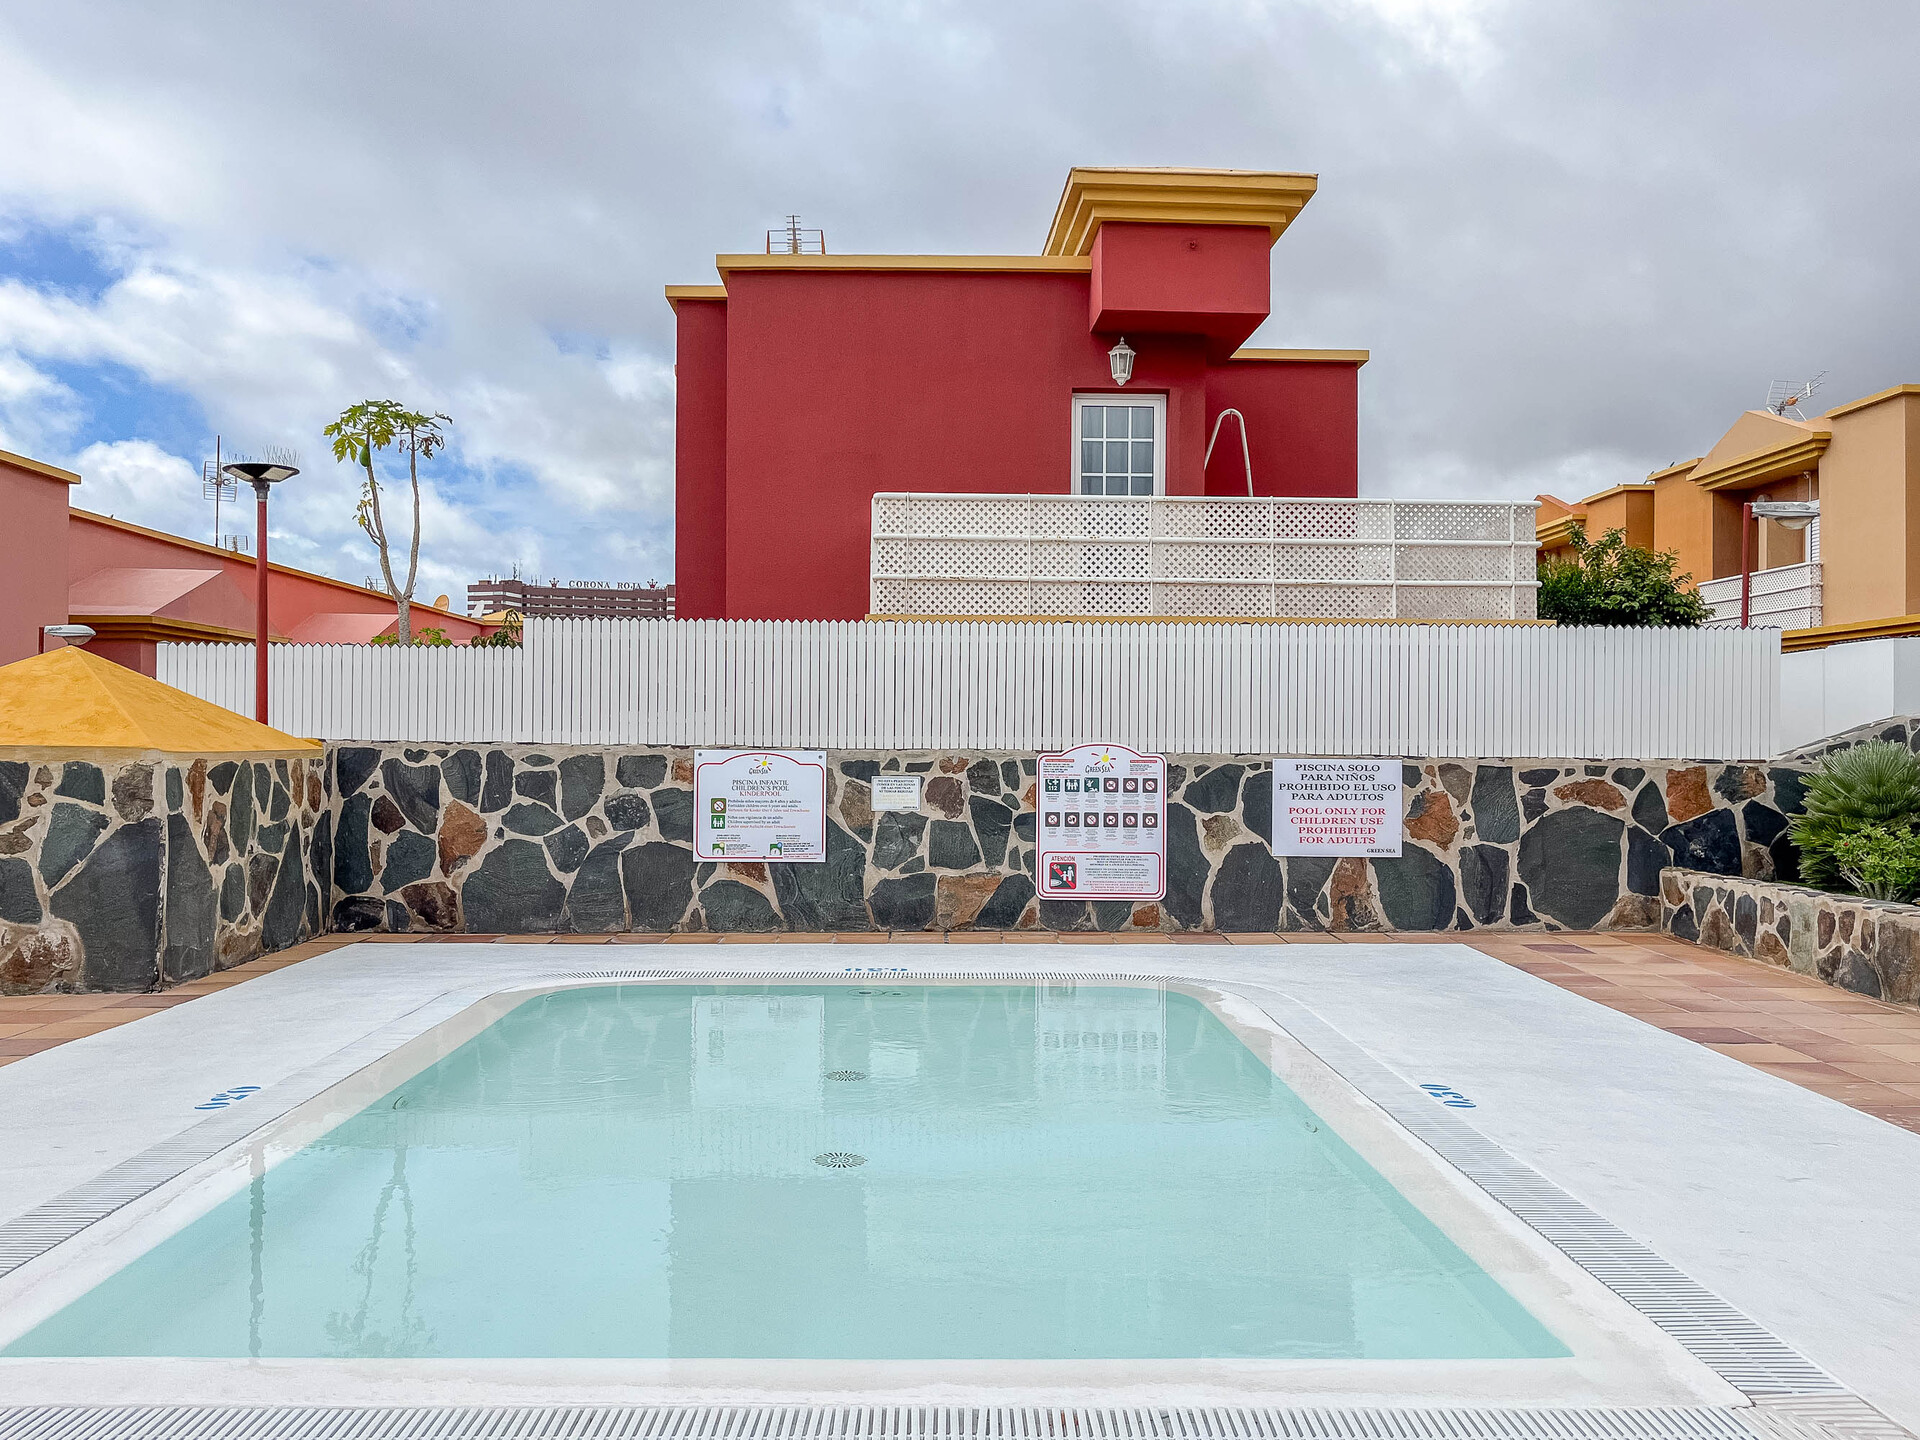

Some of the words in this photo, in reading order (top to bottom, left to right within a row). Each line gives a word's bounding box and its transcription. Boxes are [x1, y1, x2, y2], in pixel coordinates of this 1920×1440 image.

[568, 580, 610, 589] CORONA
[617, 581, 642, 590] ROJA
[1347, 764, 1381, 772] SOLO
[1335, 772, 1376, 781] NIÑOS
[1278, 783, 1350, 791] PROHIBIDO
[1353, 783, 1369, 791] EL
[1372, 783, 1397, 791] USO
[1326, 793, 1384, 801] ADULTOS
[1288, 807, 1322, 815] POOL
[1324, 807, 1358, 815] ONLY
[1361, 807, 1386, 815] FOR
[1360, 817, 1384, 825] USE
[1298, 827, 1376, 835] PROHIBITED
